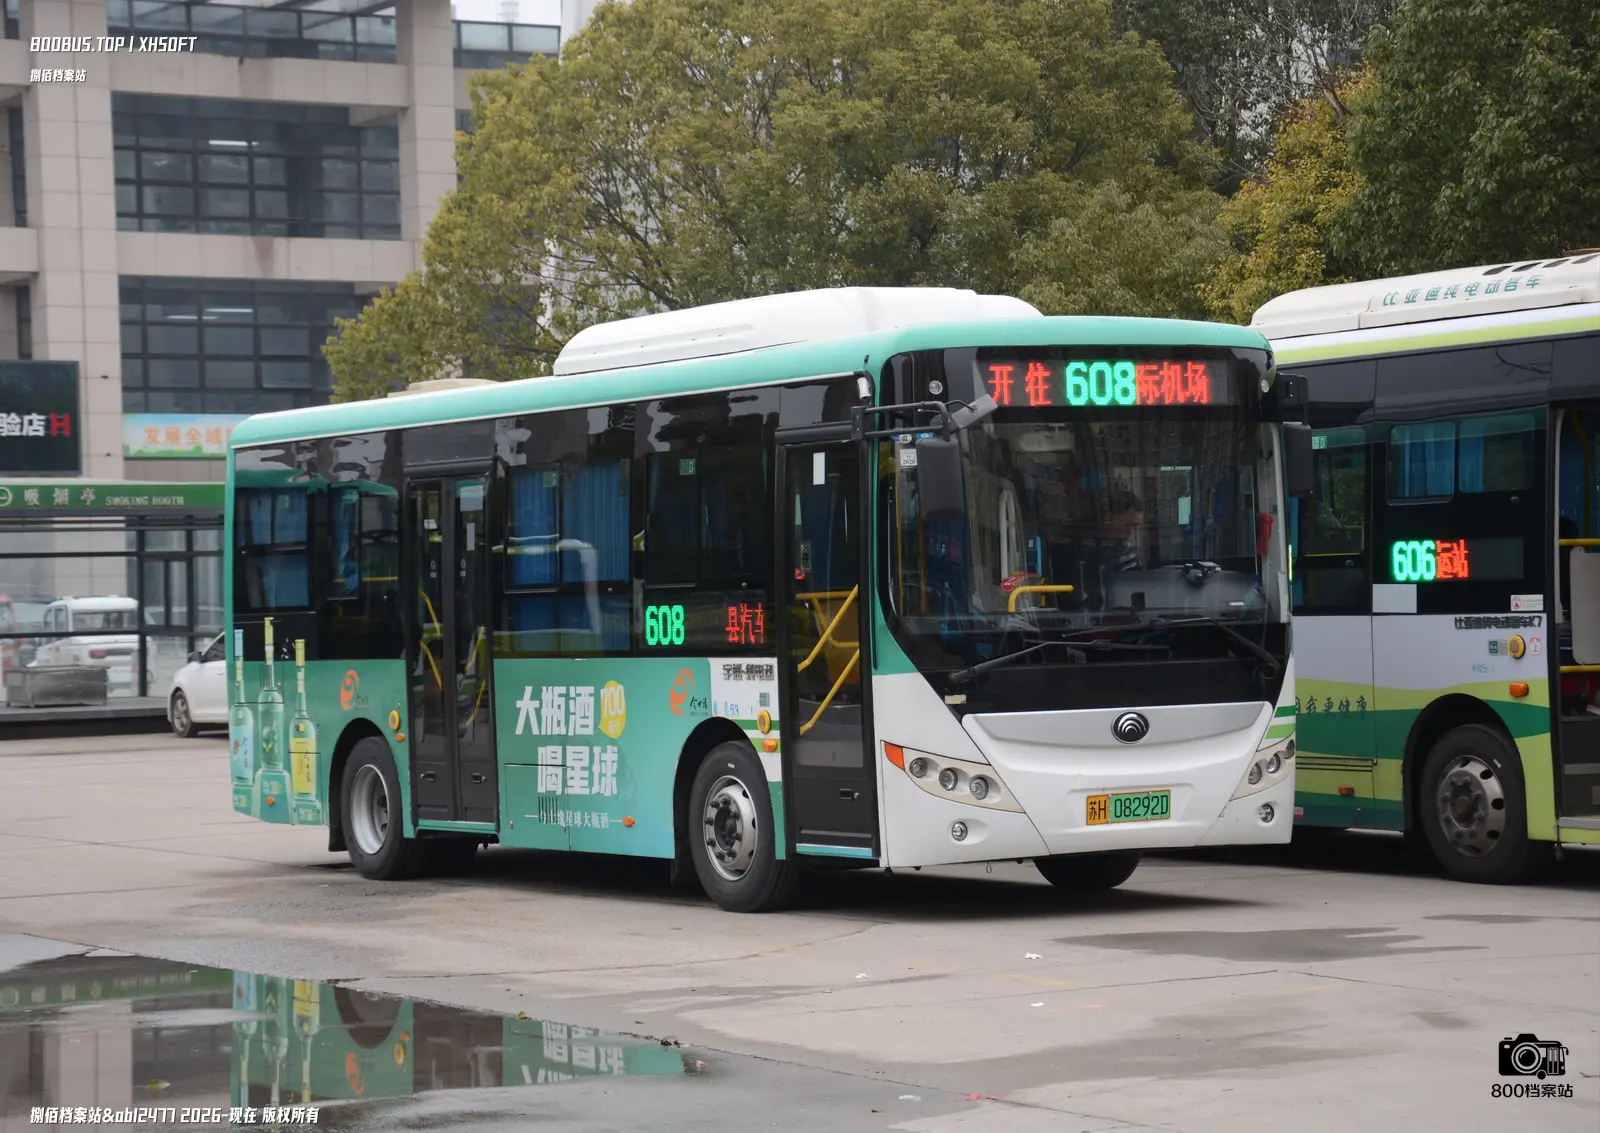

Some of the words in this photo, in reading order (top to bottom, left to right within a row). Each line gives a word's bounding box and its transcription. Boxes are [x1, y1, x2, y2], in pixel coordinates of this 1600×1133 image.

[1383, 274, 1542, 305] 比亚迪纯电动客车
[988, 361, 1051, 406] 开往
[1065, 361, 1136, 406] 608
[50, 412, 71, 438] H
[144, 426, 231, 446] 发展全域
[1393, 540, 1436, 581] 606
[645, 604, 685, 646] 608
[515, 685, 595, 736] 大瓶酒
[601, 684, 625, 718] 700
[537, 745, 618, 796] 喝星球
[1089, 799, 1107, 820] 苏H
[1114, 794, 1169, 819] 08292D
